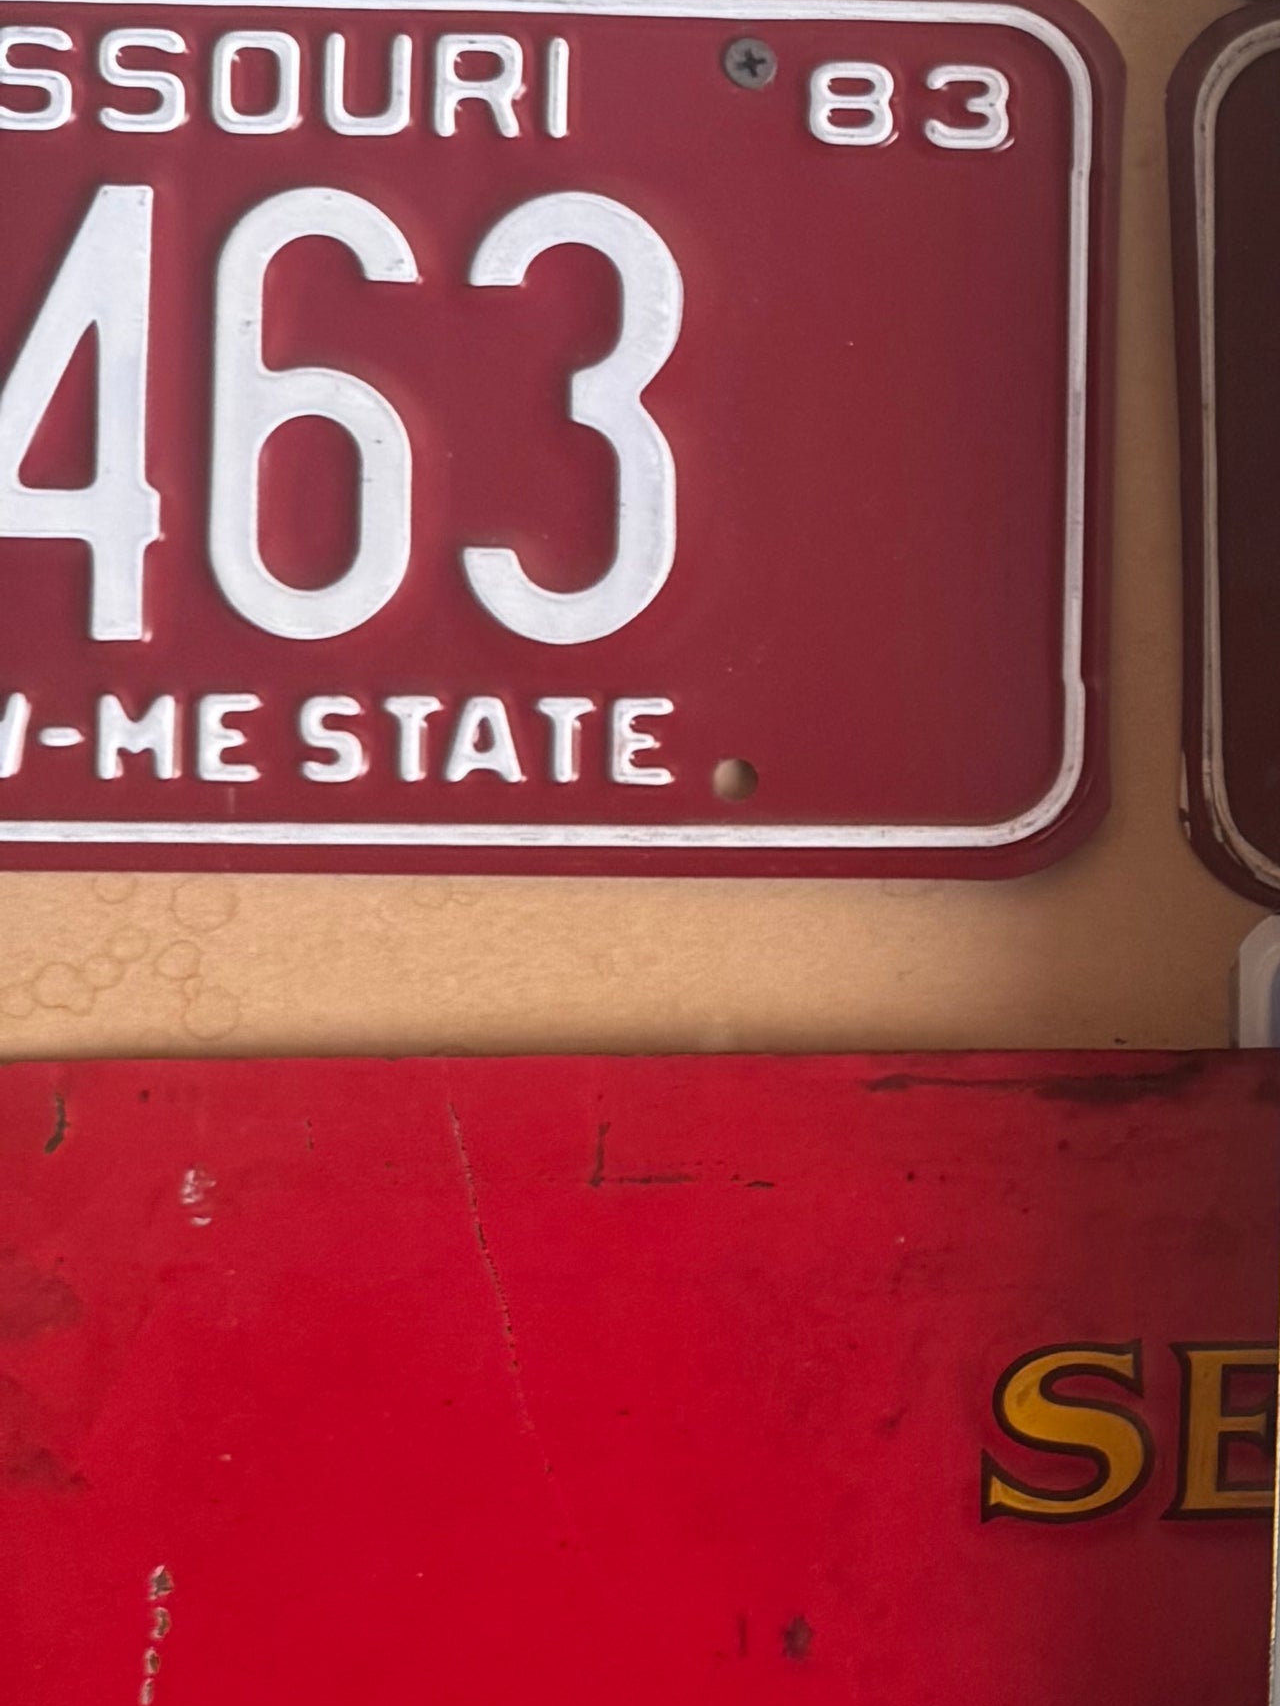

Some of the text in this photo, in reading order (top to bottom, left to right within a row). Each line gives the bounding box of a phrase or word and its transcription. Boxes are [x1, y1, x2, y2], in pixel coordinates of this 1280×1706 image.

[0, 25, 1016, 152] SSOURI 83
[0, 183, 684, 646] 463
[0, 693, 676, 787] -ME STATE
[980, 1337, 1280, 1524] SE
